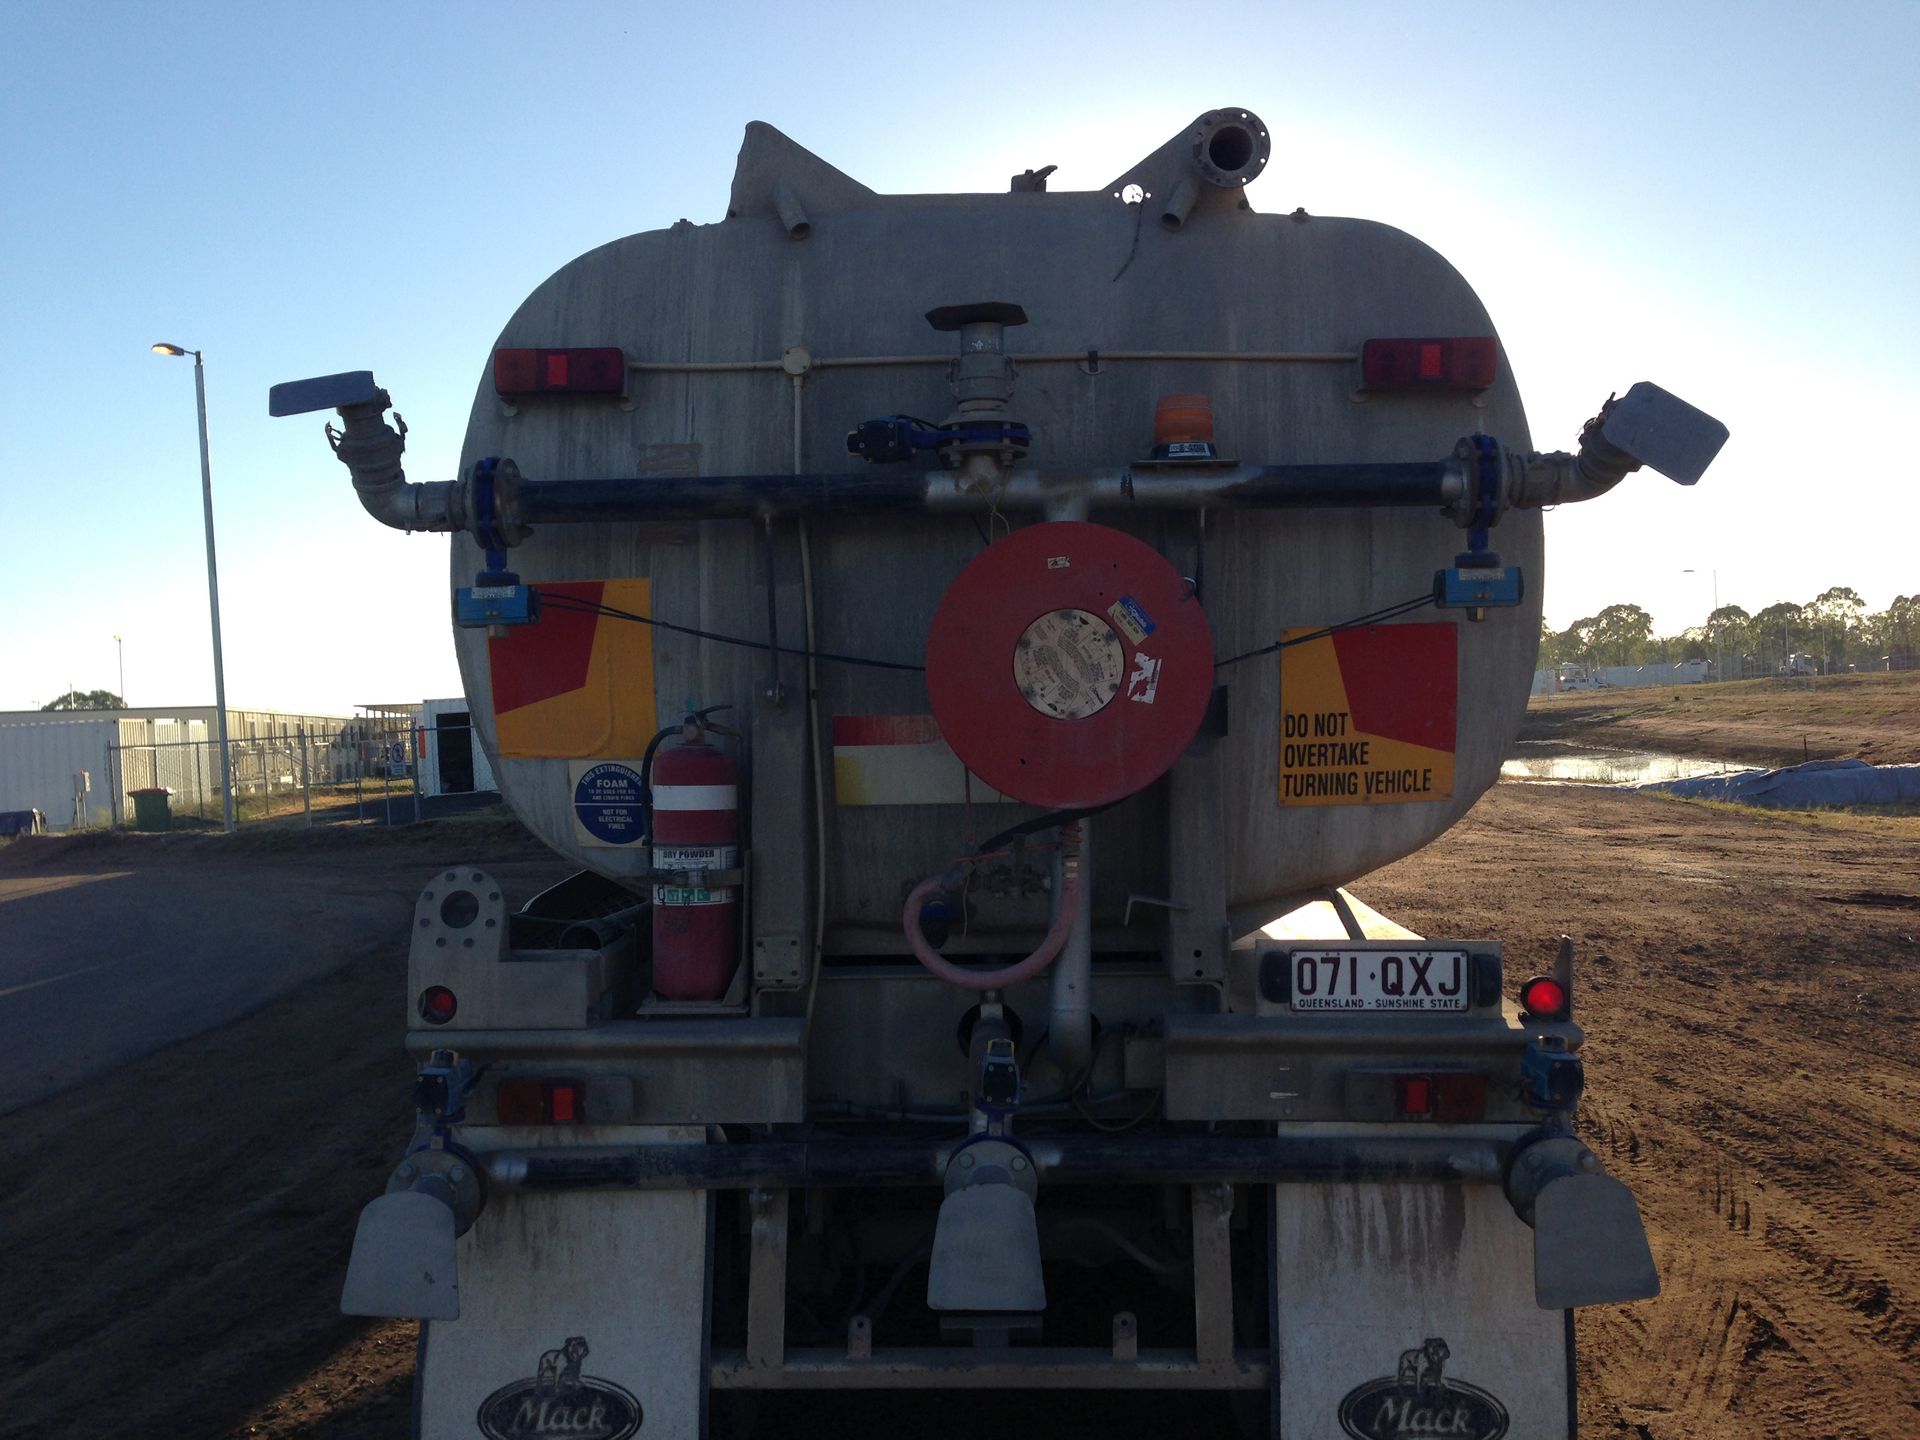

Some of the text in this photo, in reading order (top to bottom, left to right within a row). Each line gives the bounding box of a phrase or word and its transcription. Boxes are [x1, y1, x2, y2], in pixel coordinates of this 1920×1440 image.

[1285, 712, 1348, 738] DO NOT
[1284, 741, 1369, 768] OVERTAKE
[581, 772, 596, 785] THIS
[596, 779, 628, 788] FOAM
[1283, 768, 1432, 797] TURNING VEHICLE
[679, 850, 714, 858] POWDER
[1299, 998, 1364, 1008] QUEENSLAND
[1375, 998, 1425, 1008] SUNSHINE
[1430, 998, 1460, 1008] STATE
[509, 1396, 609, 1433] Mack
[1373, 1397, 1472, 1433] Mack
